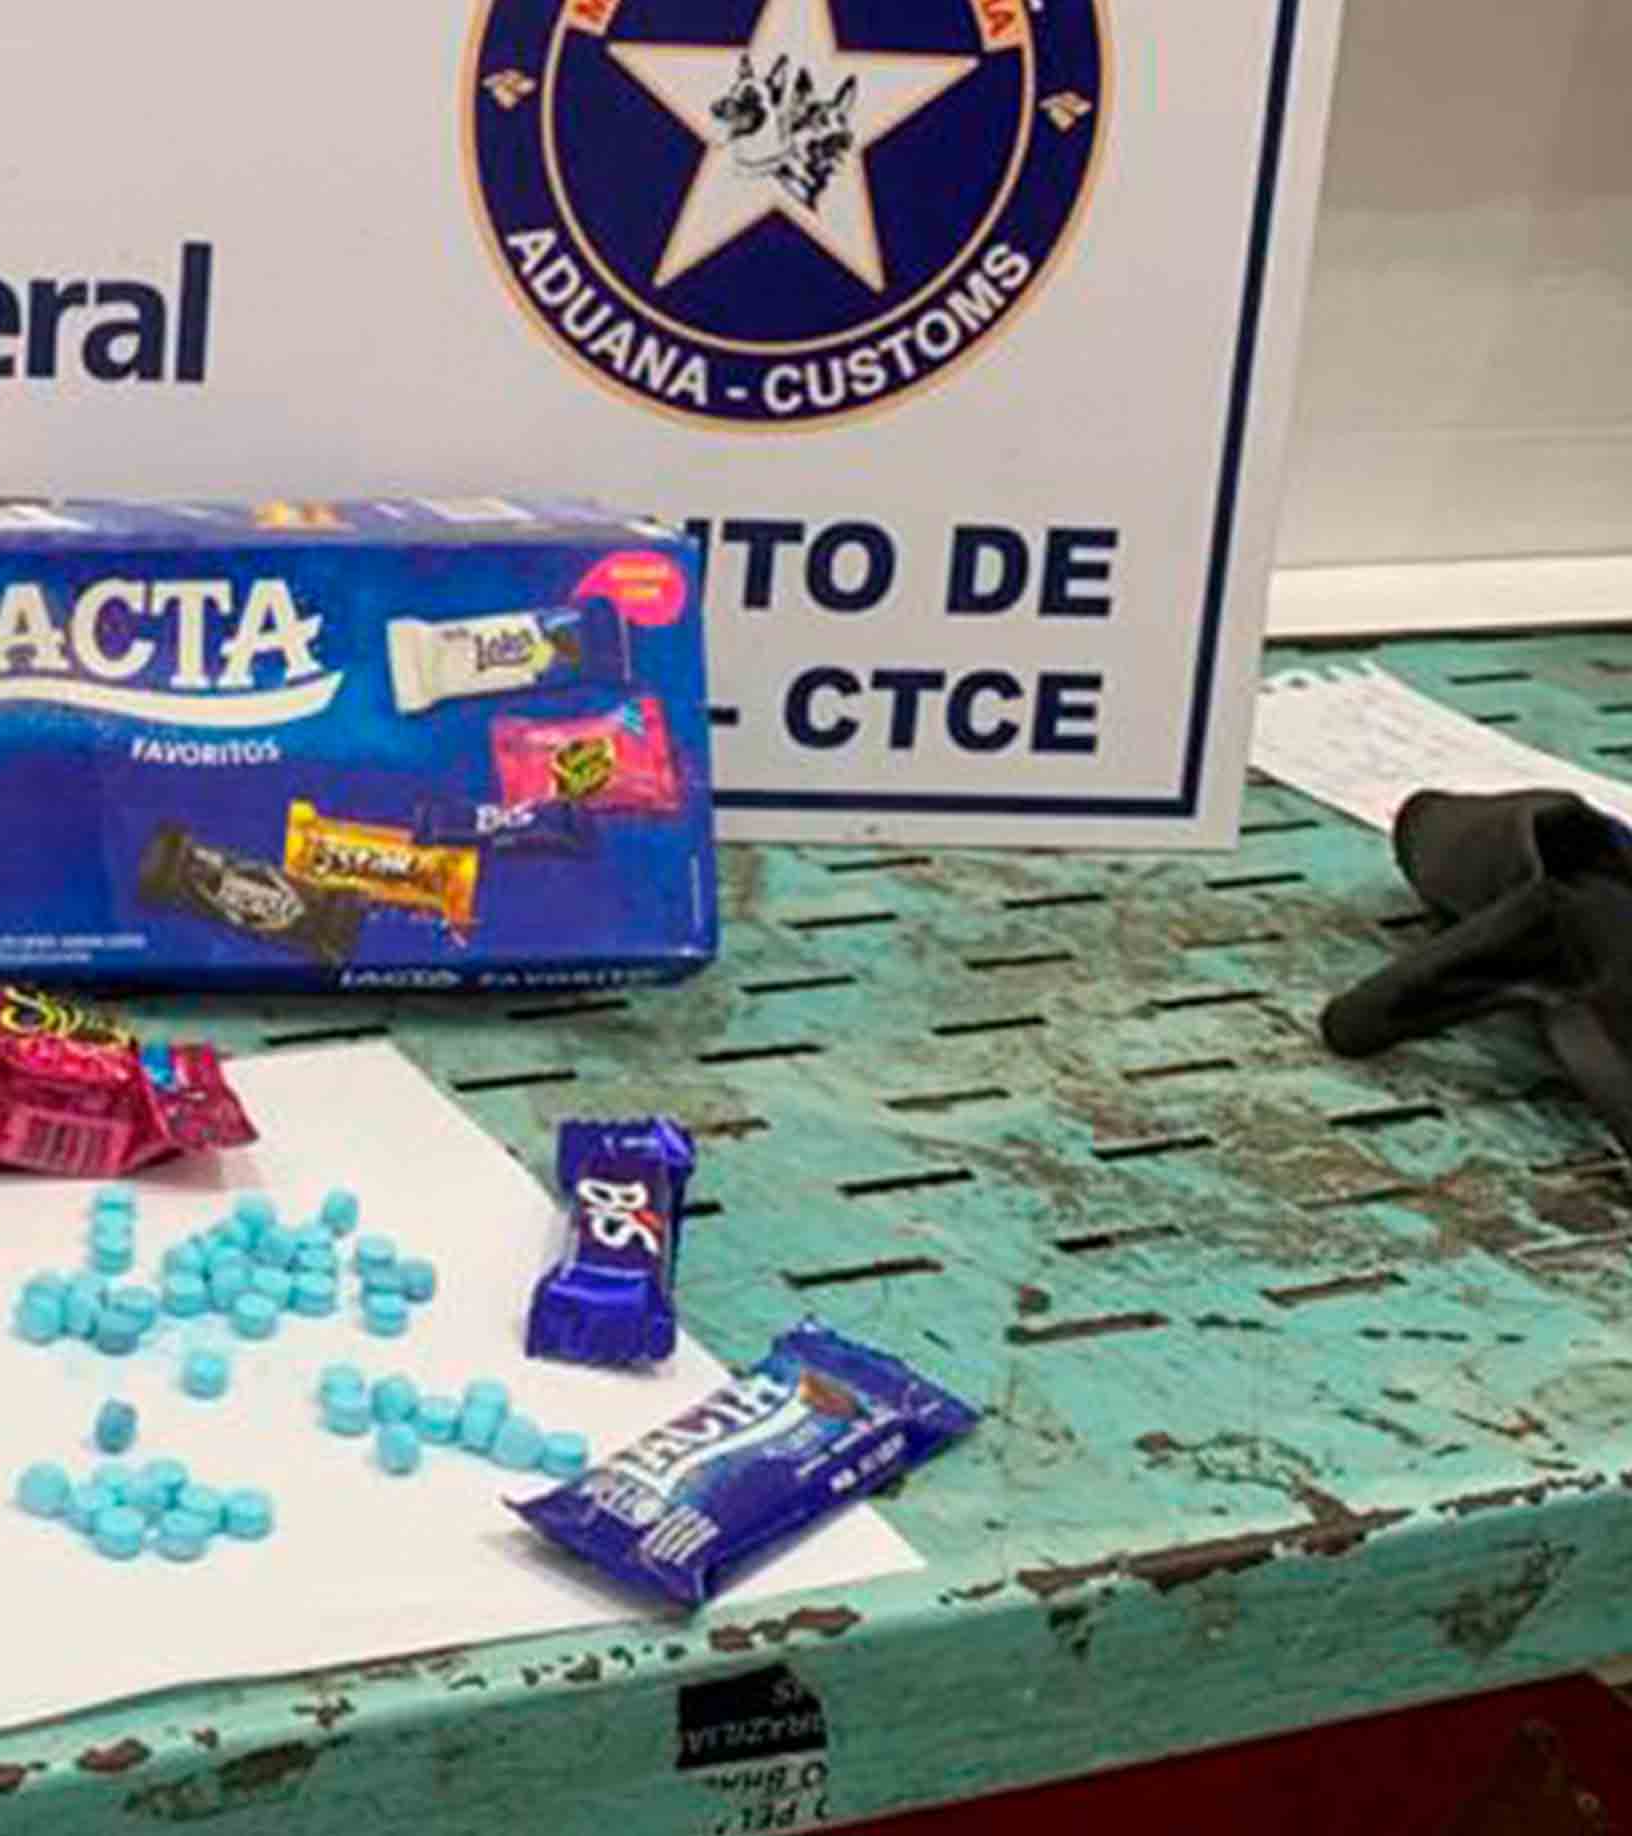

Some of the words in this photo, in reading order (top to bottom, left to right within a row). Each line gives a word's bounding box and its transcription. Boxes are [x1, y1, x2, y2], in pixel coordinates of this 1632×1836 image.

[507, 226, 710, 406] ADUANA
[763, 241, 1033, 413] CUSTOMS
[945, 524, 1119, 617] DE
[131, 736, 281, 767] FAVORITOS
[783, 665, 1104, 754] CTCE
